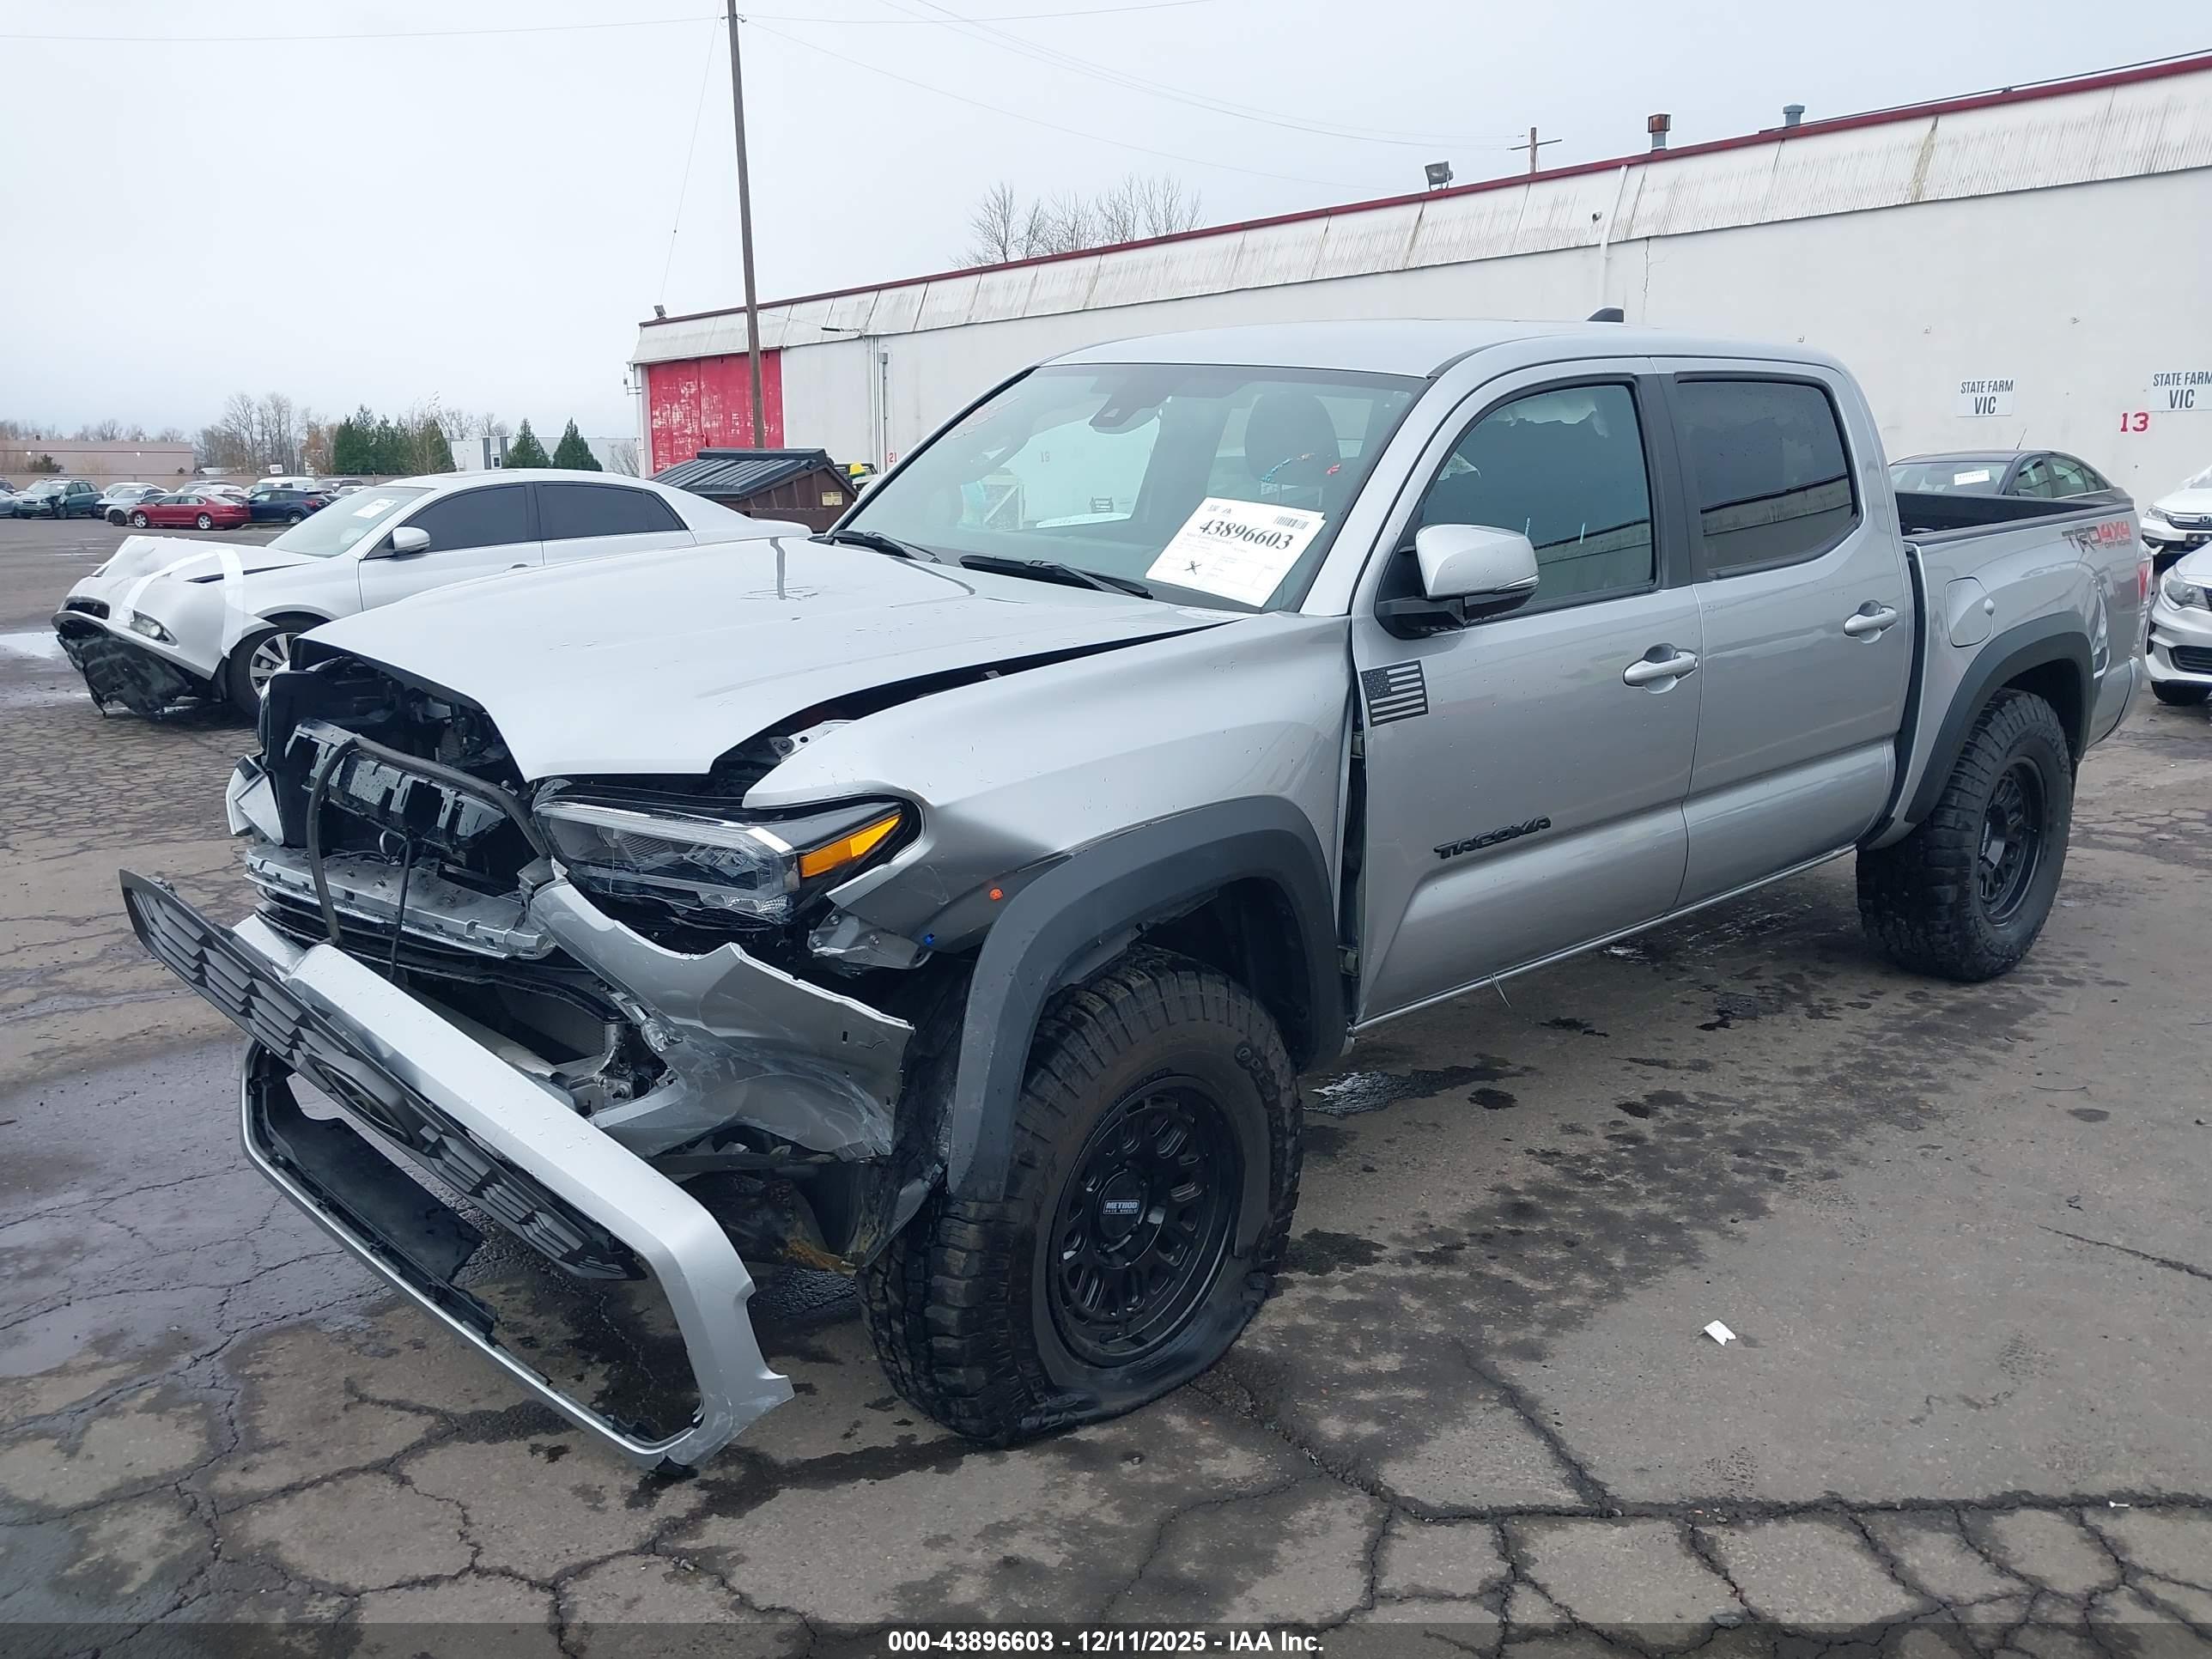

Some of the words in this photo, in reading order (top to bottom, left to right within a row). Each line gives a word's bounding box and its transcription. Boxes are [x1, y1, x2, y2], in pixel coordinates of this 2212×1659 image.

[1960, 381, 1985, 394] STATE
[1987, 380, 2014, 392] FARM
[2153, 373, 2182, 386] STATE
[1974, 396, 1996, 415] VIC
[2169, 389, 2195, 409] VIC
[2120, 412, 2150, 432] 13
[889, 453, 897, 463] 21
[1200, 519, 1294, 550] 43896603
[1433, 815, 1552, 860] TACOMA
